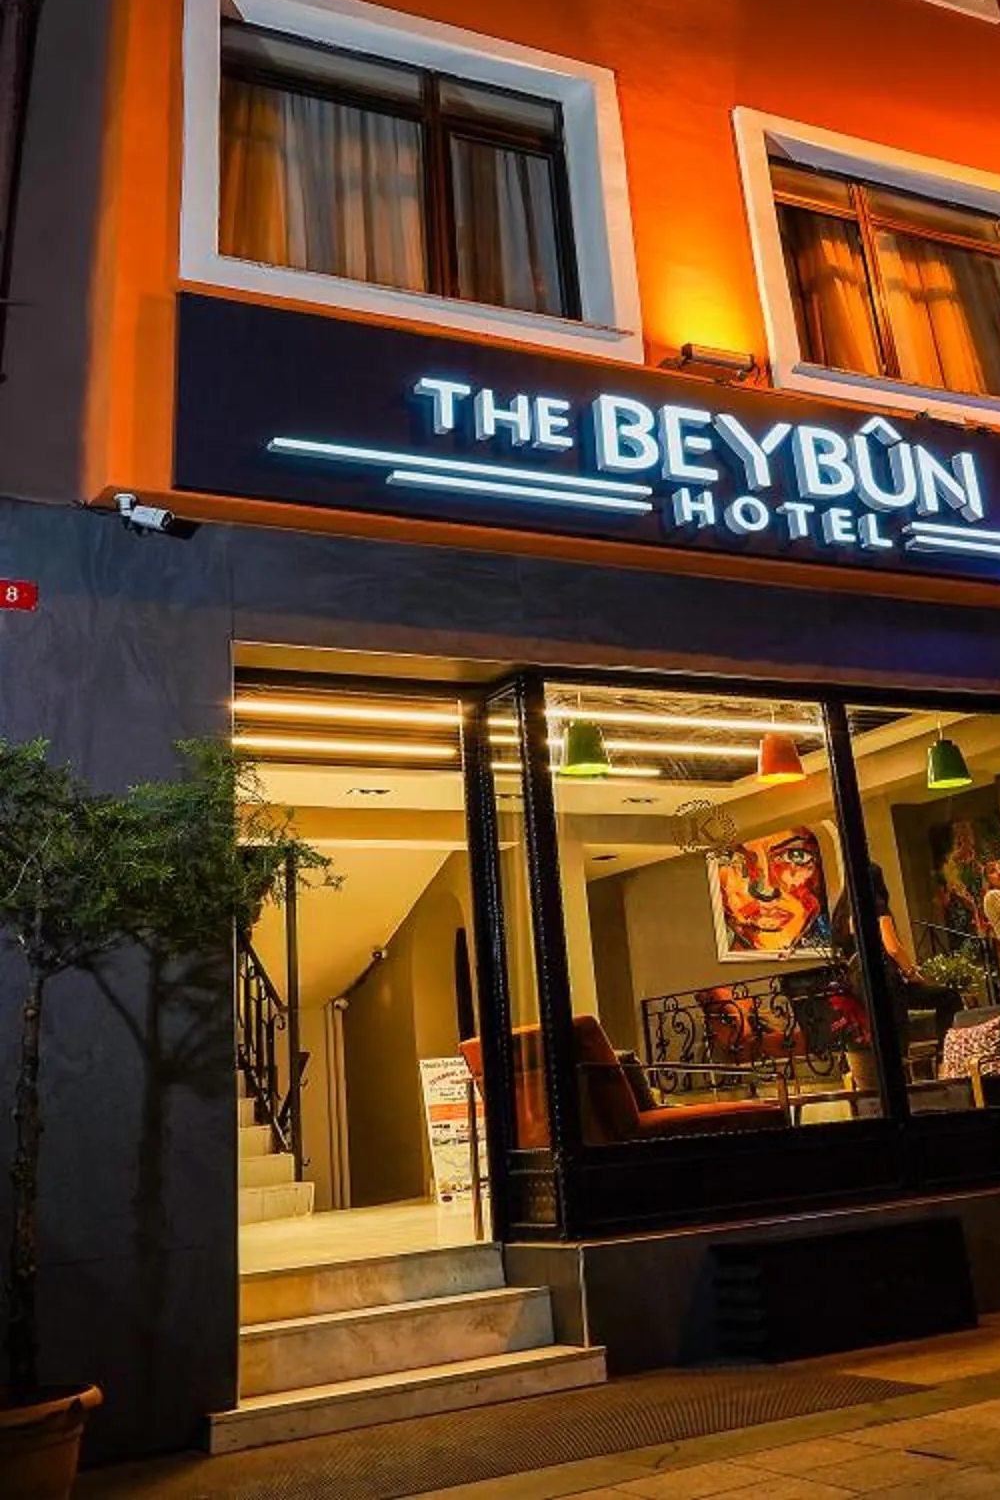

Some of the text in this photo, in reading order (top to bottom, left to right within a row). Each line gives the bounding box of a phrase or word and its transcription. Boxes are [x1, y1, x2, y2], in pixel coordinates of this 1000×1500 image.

[415, 377, 986, 523] THE BEYBÛN
[672, 487, 893, 549] HOTEL
[5, 585, 18, 602] 8
